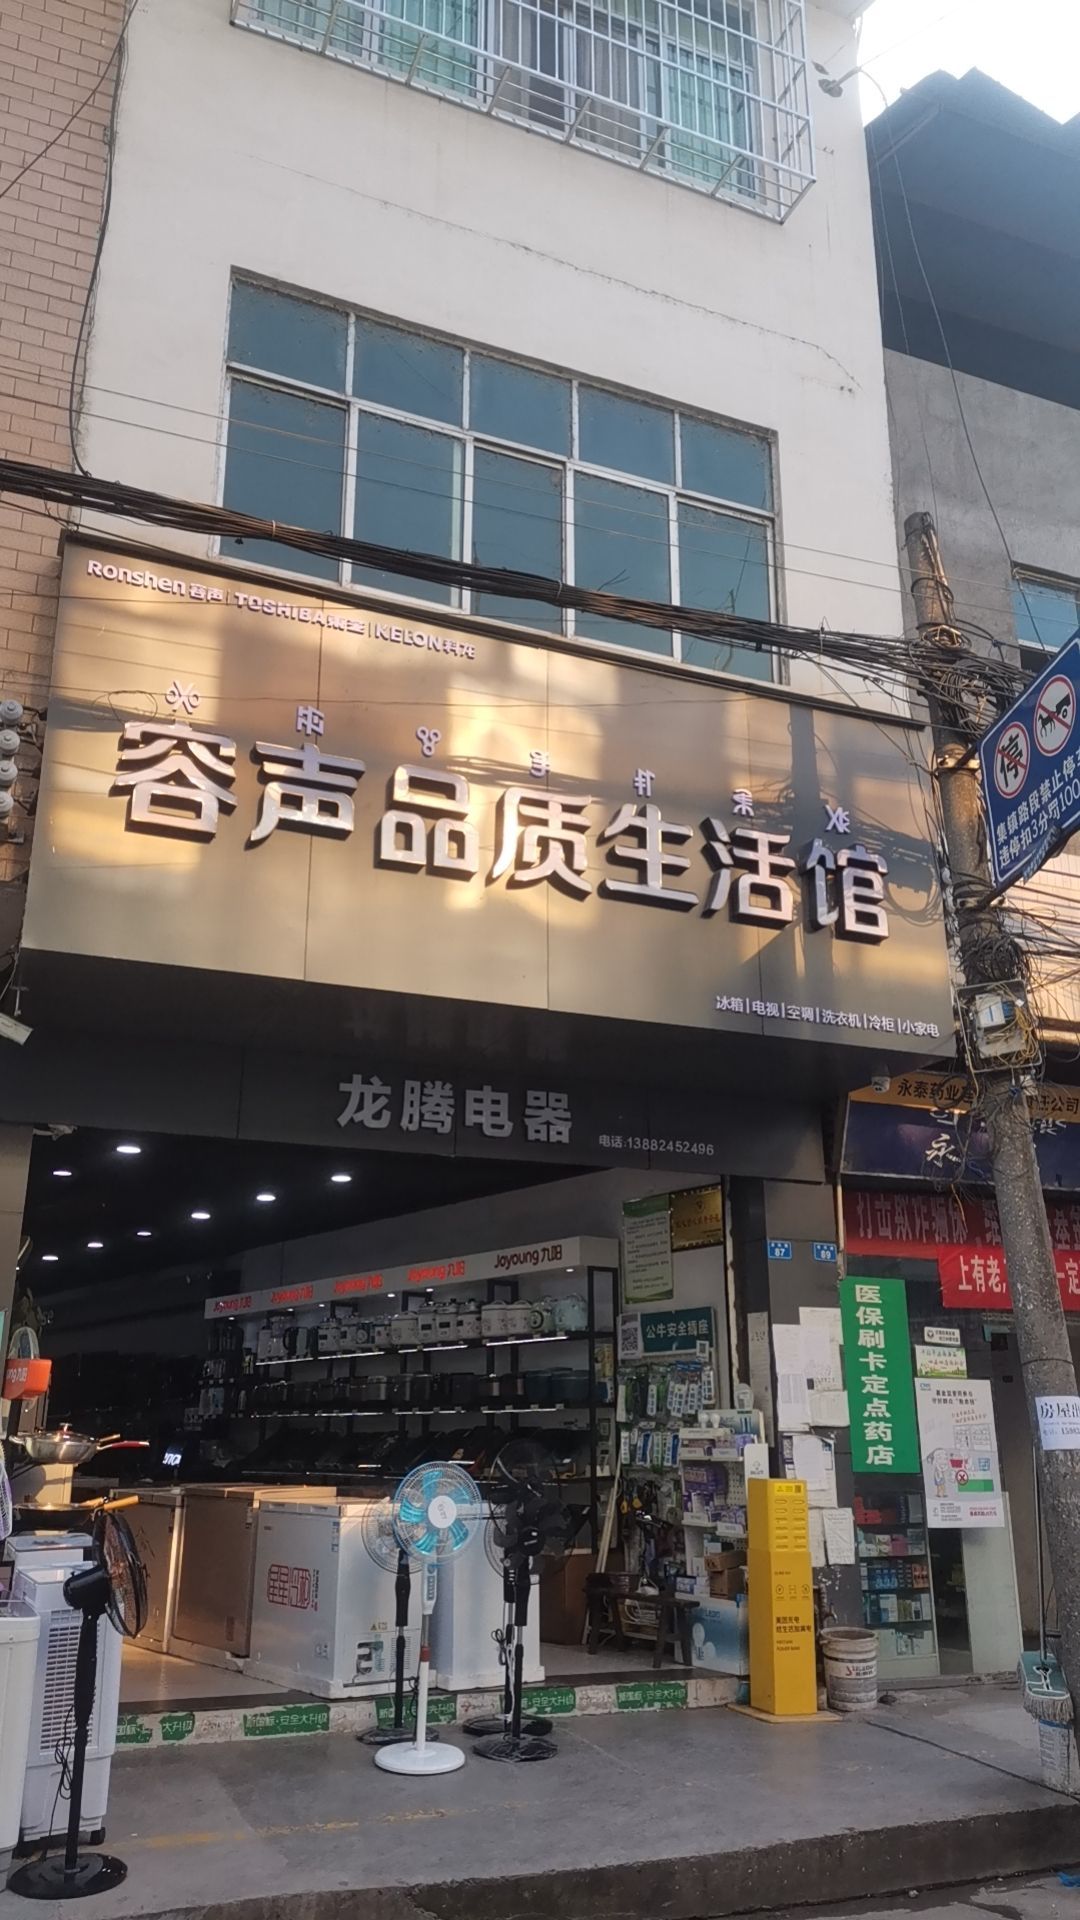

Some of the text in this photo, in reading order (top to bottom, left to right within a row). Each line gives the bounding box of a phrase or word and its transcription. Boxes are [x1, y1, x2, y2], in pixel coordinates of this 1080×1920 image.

[87, 559, 186, 596] Ronshen
[189, 582, 224, 602] 容声
[234, 591, 326, 628] TOSHIBA
[375, 623, 442, 652] KELON
[443, 639, 476, 659] 科龙
[109, 718, 889, 944] 容声品质生活馆
[997, 746, 1080, 845] 集镇路段禁止停
[337, 1074, 571, 1144] 龙腾电器
[494, 1244, 562, 1270] Joyoung 九阳
[774, 1247, 786, 1257] 87
[646, 1319, 709, 1339] 公牛安全插座
[855, 1284, 895, 1466] 医保刷卡定点药店
